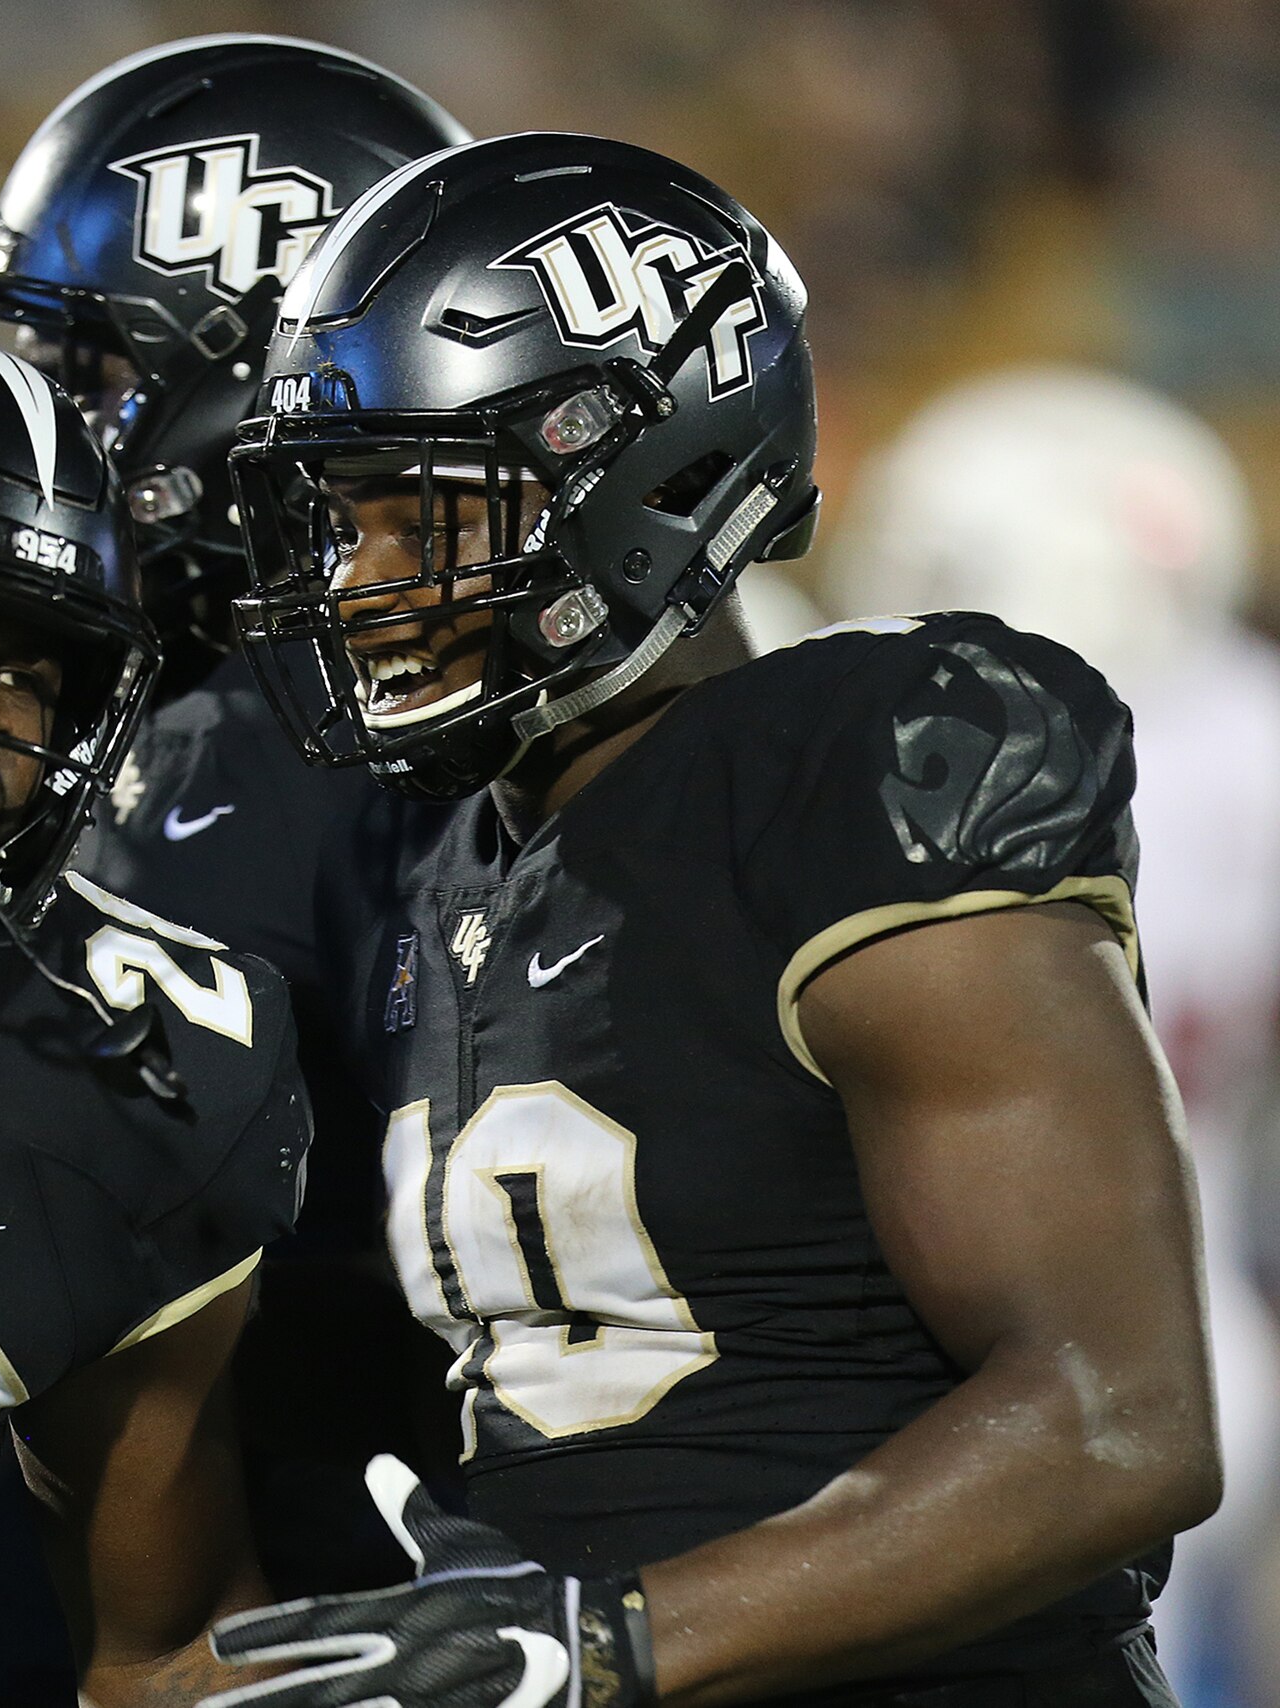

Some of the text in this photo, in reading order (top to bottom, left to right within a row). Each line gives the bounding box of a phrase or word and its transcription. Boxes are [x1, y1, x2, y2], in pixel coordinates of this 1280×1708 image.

[487, 201, 769, 403] UCF
[271, 378, 311, 413] 404
[11, 529, 78, 575] 954
[450, 908, 492, 990] UCF
